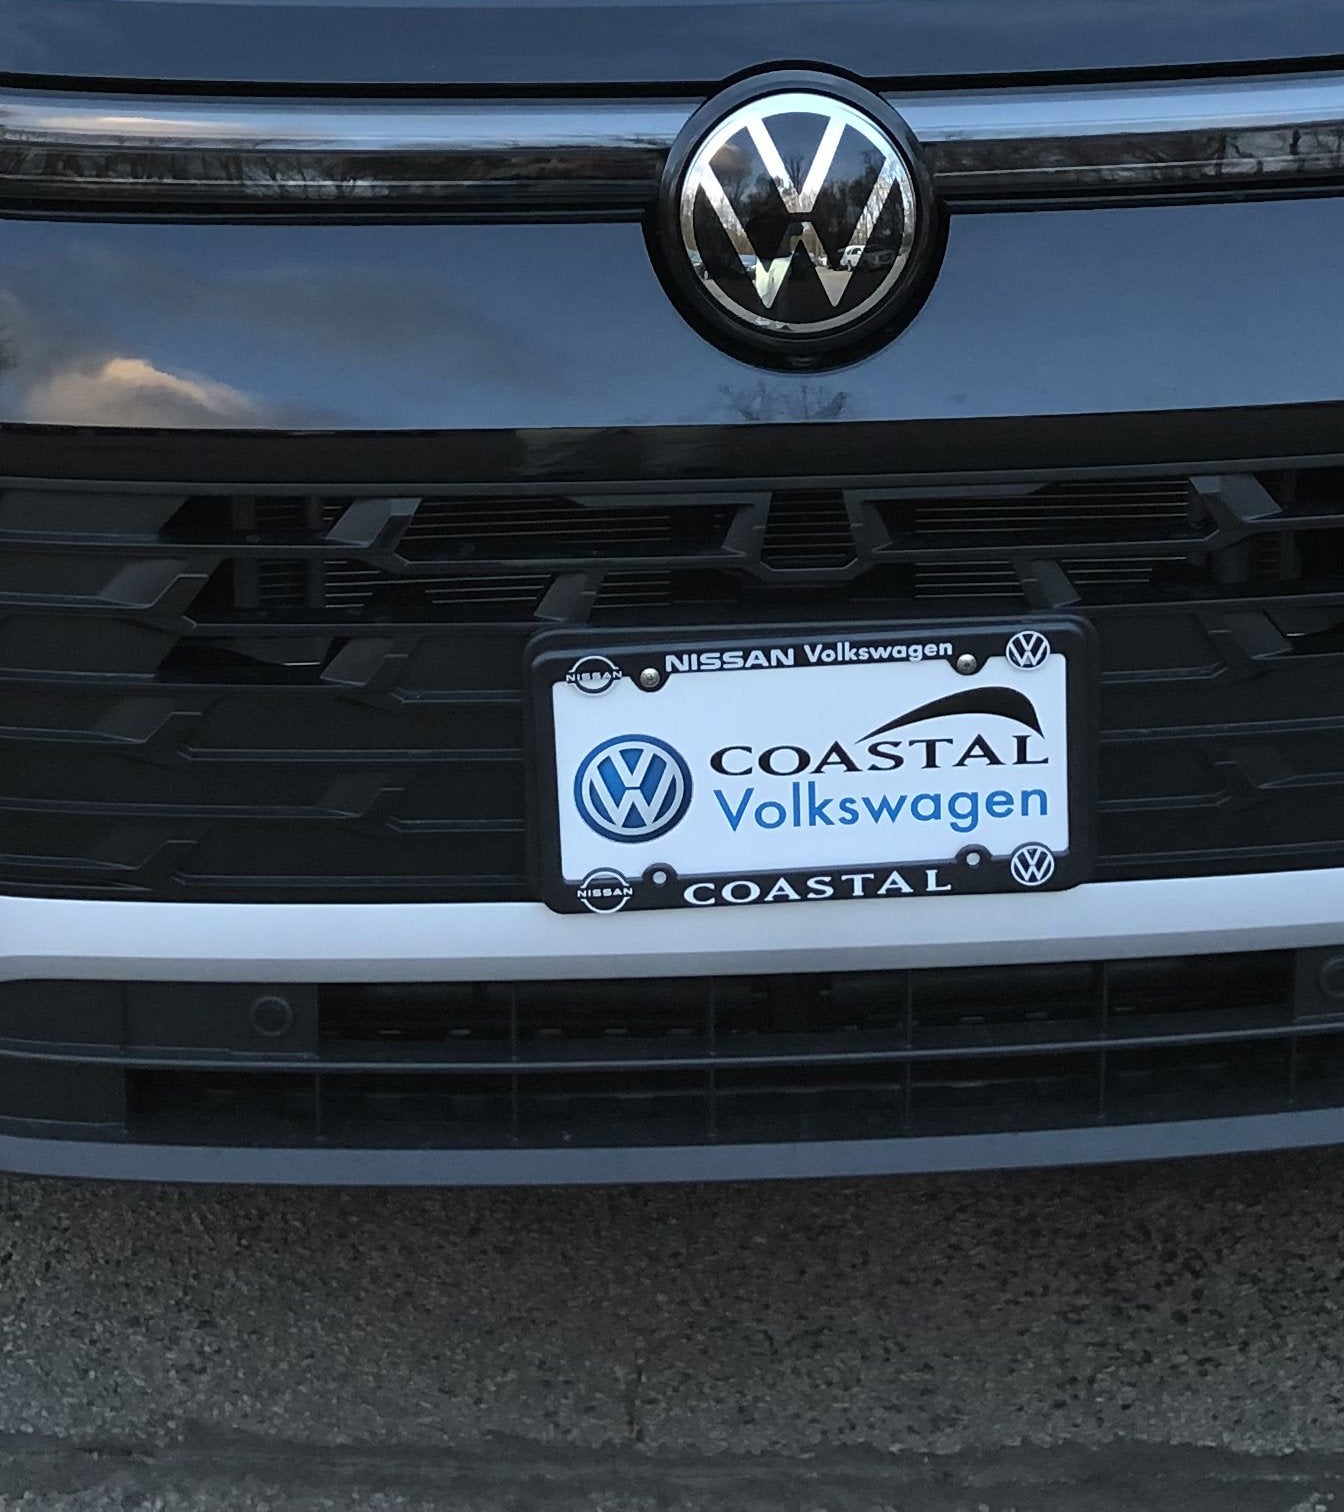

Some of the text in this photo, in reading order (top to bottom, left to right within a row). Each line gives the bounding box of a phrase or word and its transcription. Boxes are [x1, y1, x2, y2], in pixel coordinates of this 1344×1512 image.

[665, 640, 954, 673] NISSAN Volkswagen
[565, 670, 623, 683] NISSAN
[709, 733, 1050, 777] COASTAL
[712, 780, 1049, 833] Volkswagen
[576, 887, 633, 898] NISSAN
[683, 870, 953, 906] COASTAL
